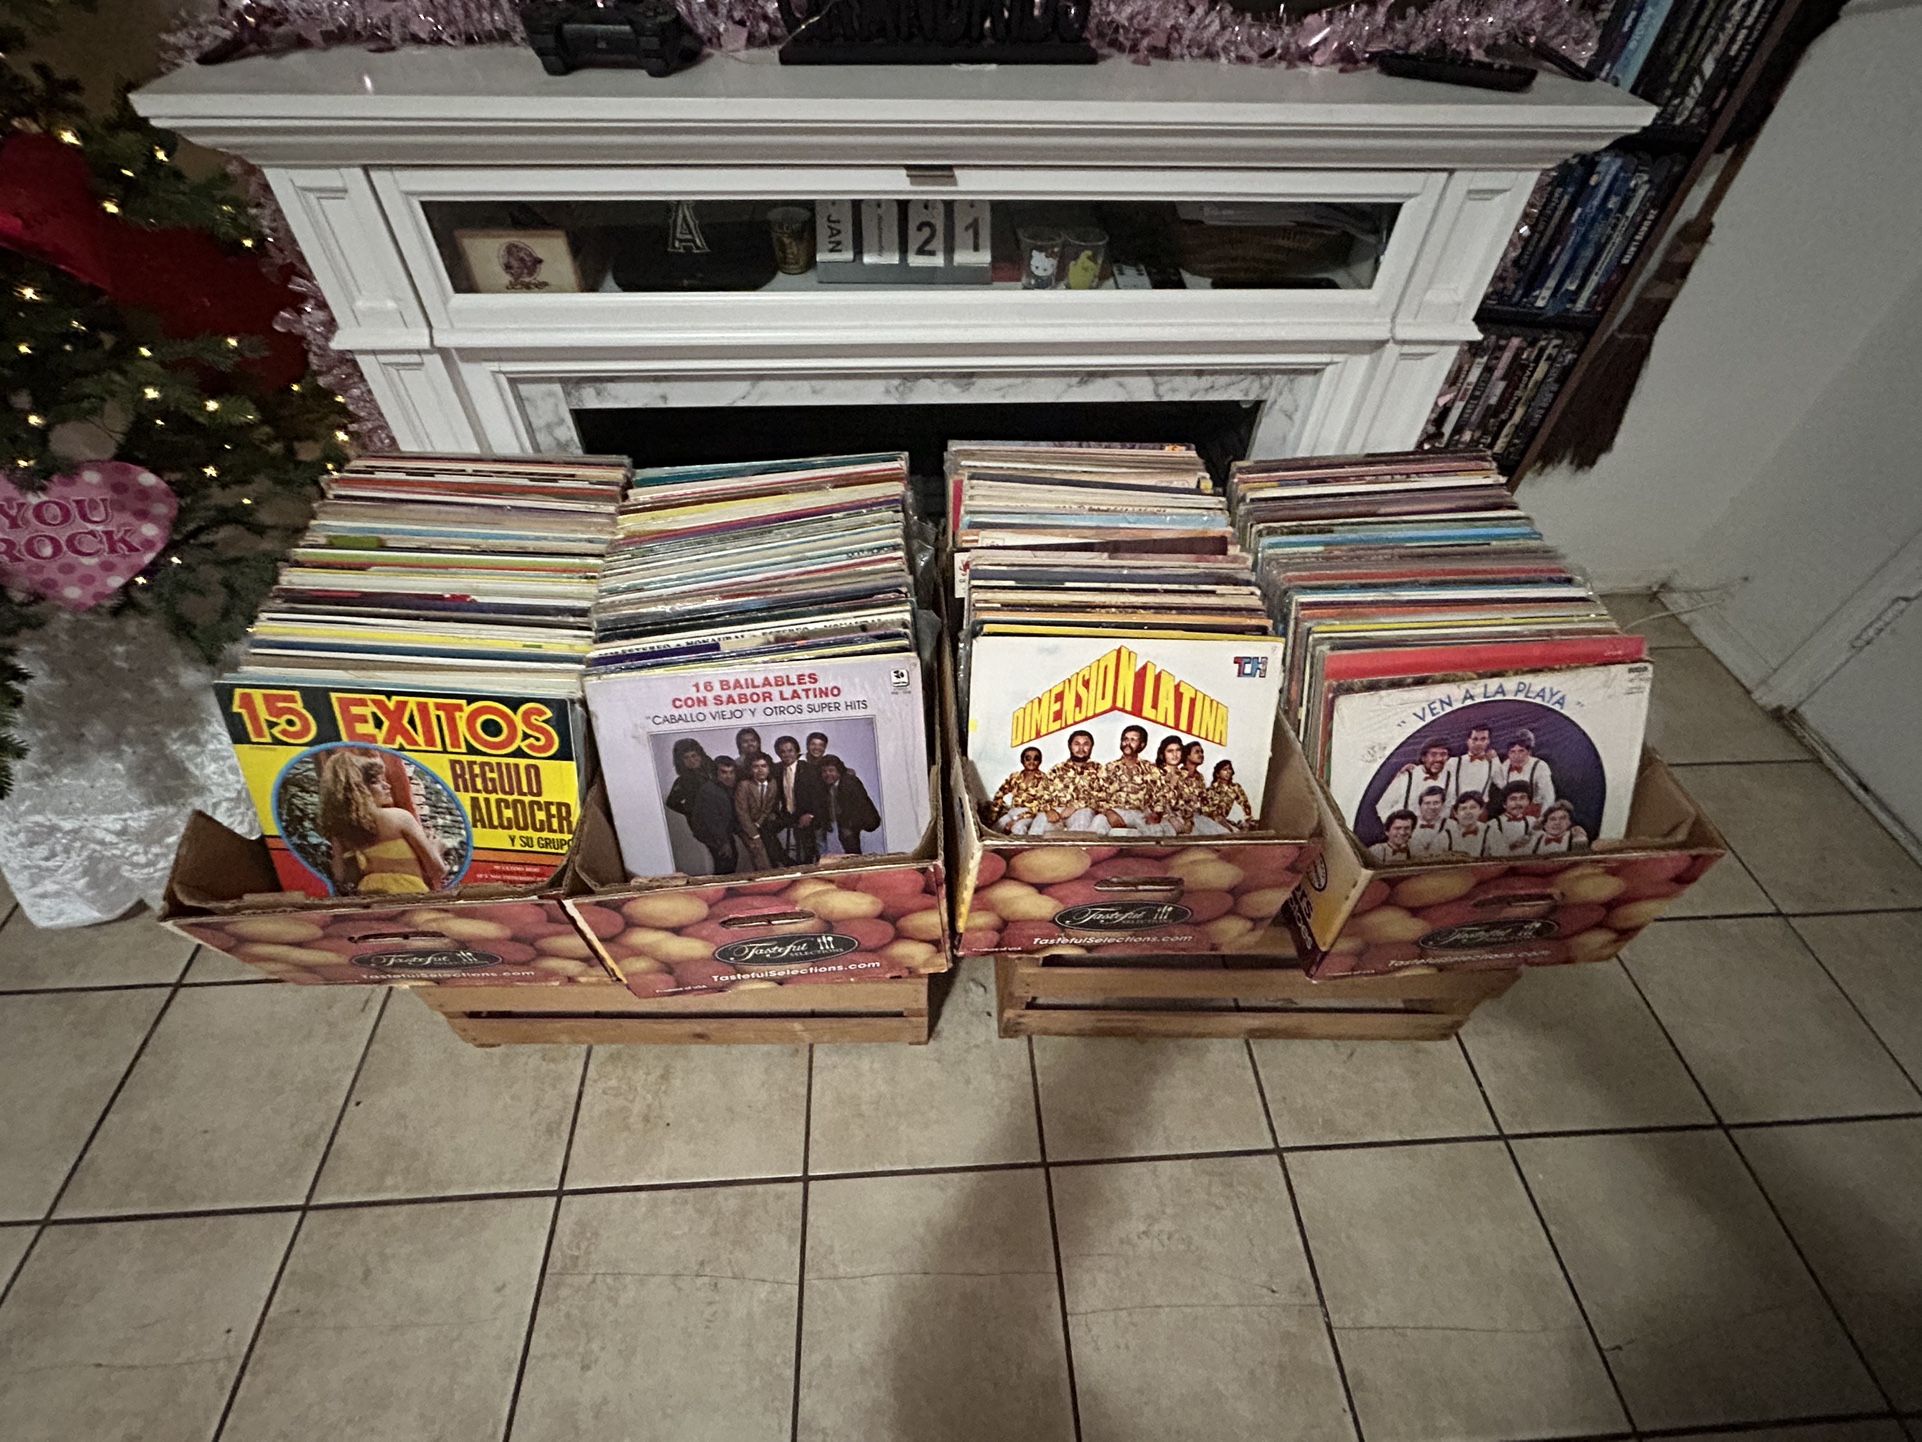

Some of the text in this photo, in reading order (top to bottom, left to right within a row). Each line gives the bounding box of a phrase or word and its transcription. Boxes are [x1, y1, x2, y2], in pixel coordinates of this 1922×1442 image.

[826, 214, 843, 254] JAN
[914, 220, 938, 257] 2
[964, 215, 981, 254] 1
[0, 498, 112, 529] YOU
[0, 528, 143, 563] ROCK
[672, 685, 842, 709] CON SABOR LATINO
[692, 672, 819, 694] 16 BAILABLES
[1011, 645, 1229, 748] DIMENSION LATINA
[749, 707, 758, 718] Y
[762, 704, 804, 717] OTROS
[806, 702, 842, 715] SUPER
[844, 699, 868, 712] HITS
[1412, 681, 1568, 723] VEN A LA PLAYA
[233, 687, 559, 757] 15 EXITOS
[449, 758, 543, 798] REGULO
[470, 796, 575, 835] ALCOCER
[508, 834, 516, 847] Y
[519, 835, 534, 848] SU
[730, 937, 814, 961] Tasteful
[1032, 935, 1193, 946] TastefulSelections.com
[711, 961, 881, 983] TastefulSelections.com
